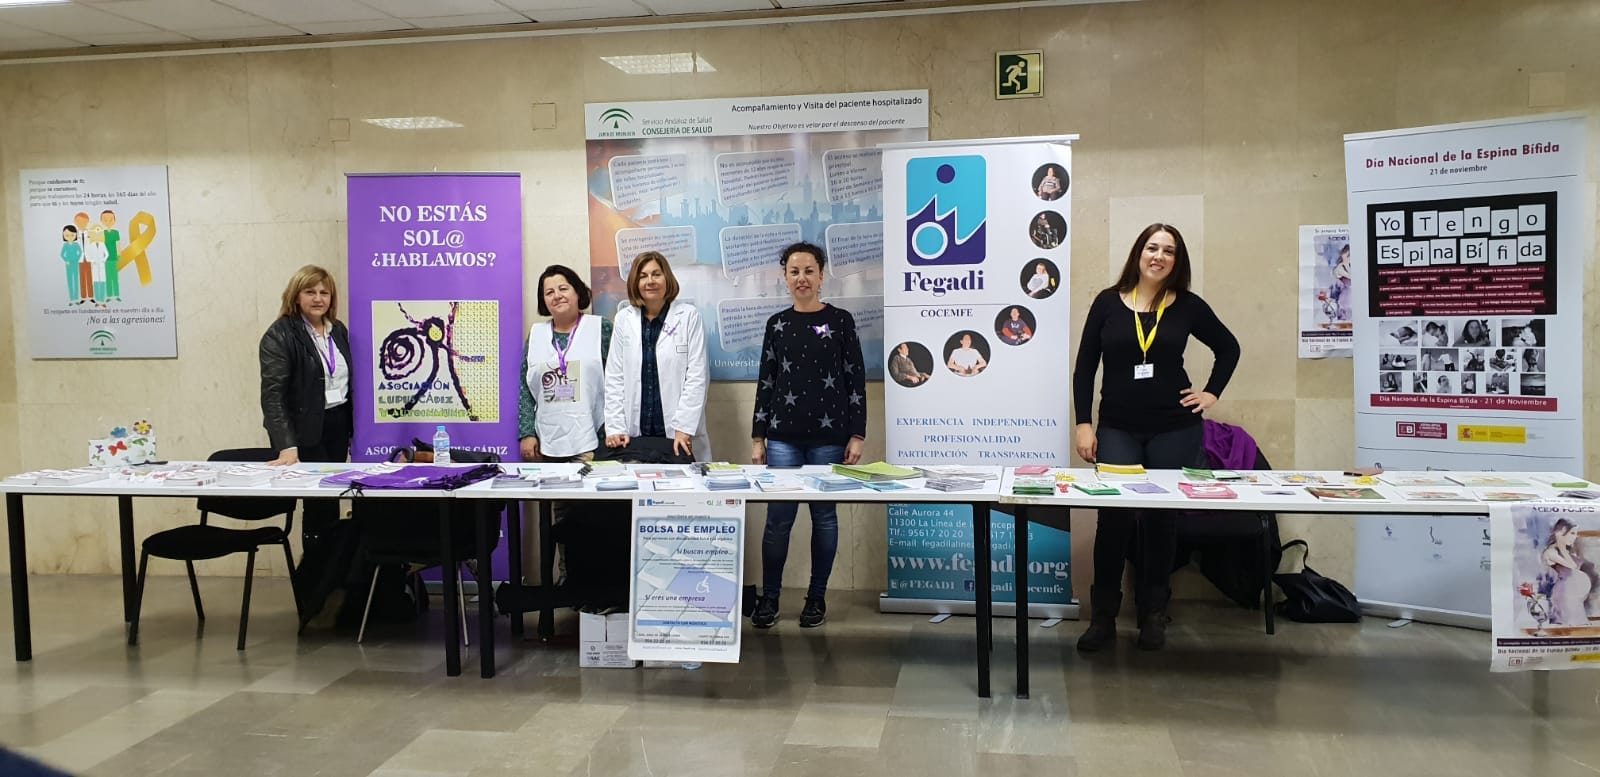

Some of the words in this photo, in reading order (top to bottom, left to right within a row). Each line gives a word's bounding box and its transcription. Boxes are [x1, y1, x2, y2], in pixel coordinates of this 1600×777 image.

[731, 102, 796, 113] Acompañamiento
[803, 101, 824, 110] Visita
[825, 100, 837, 109] del
[838, 99, 871, 110] paciente
[872, 96, 923, 108] hospitalizado
[748, 123, 772, 131] Nuestro
[772, 122, 797, 131] Objetivo
[805, 121, 821, 129] velar
[868, 118, 878, 126] del
[878, 118, 906, 127] paciente
[642, 126, 681, 136] CONSEJERÍA
[691, 126, 713, 134] SALUD
[1388, 152, 1438, 167] Nacional
[1442, 151, 1457, 162] de
[1461, 149, 1472, 160] la
[1477, 146, 1517, 160] Espina
[1522, 141, 1560, 155] Bífida
[1439, 167, 1448, 175] de
[1449, 164, 1488, 174] noviembre
[379, 205, 412, 222] NO
[417, 201, 487, 222] ESTÁS
[1380, 217, 1401, 231] Yo
[1419, 212, 1538, 233] Tengo
[403, 229, 465, 248] SOL@
[1381, 244, 1454, 264] Espina
[1466, 242, 1543, 261] Bífida
[371, 252, 497, 267] ¿HABLAMOS?
[903, 270, 984, 297] Fegadi
[920, 308, 974, 318] COCEMFE
[86, 315, 101, 326] ¡No
[109, 315, 120, 324] las
[121, 315, 166, 325] agresiones!
[1507, 398, 1547, 406] Noviembre
[896, 418, 964, 426] EXPERIENCIA
[972, 418, 1057, 427] INDEPENDENCIA
[924, 435, 1021, 444] PROFESIONALIDAD
[898, 449, 968, 458] PARTICIPACIÓN
[979, 451, 1056, 459] TRANSPARENCIA
[889, 508, 909, 516] Calle
[911, 508, 941, 517] Aurora
[943, 509, 954, 517] 44
[889, 518, 916, 527] 11300
[918, 519, 928, 527] La
[955, 520, 967, 528] de
[640, 525, 673, 533] BOLSA
[677, 525, 690, 533] DE
[694, 525, 736, 533] EMPLEO
[938, 529, 950, 537] 20
